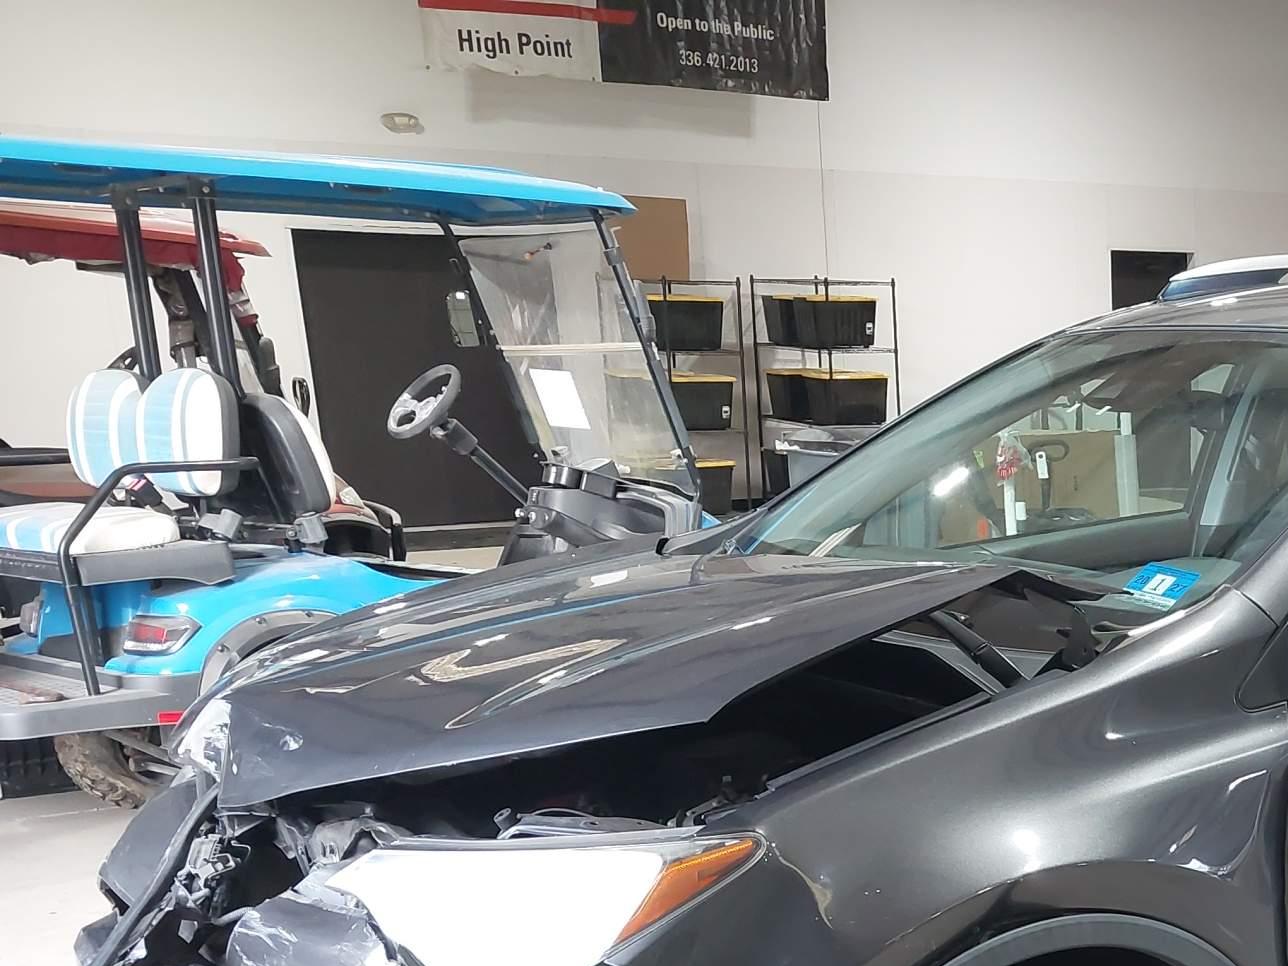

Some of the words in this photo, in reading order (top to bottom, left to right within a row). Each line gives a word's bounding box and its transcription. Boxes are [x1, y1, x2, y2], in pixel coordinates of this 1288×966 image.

[656, 12, 692, 32] Open
[694, 18, 709, 32] to
[711, 19, 731, 34] the
[733, 21, 775, 40] Public
[457, 29, 511, 59] High
[517, 33, 573, 58] Point
[679, 49, 759, 73] 336.421.2013
